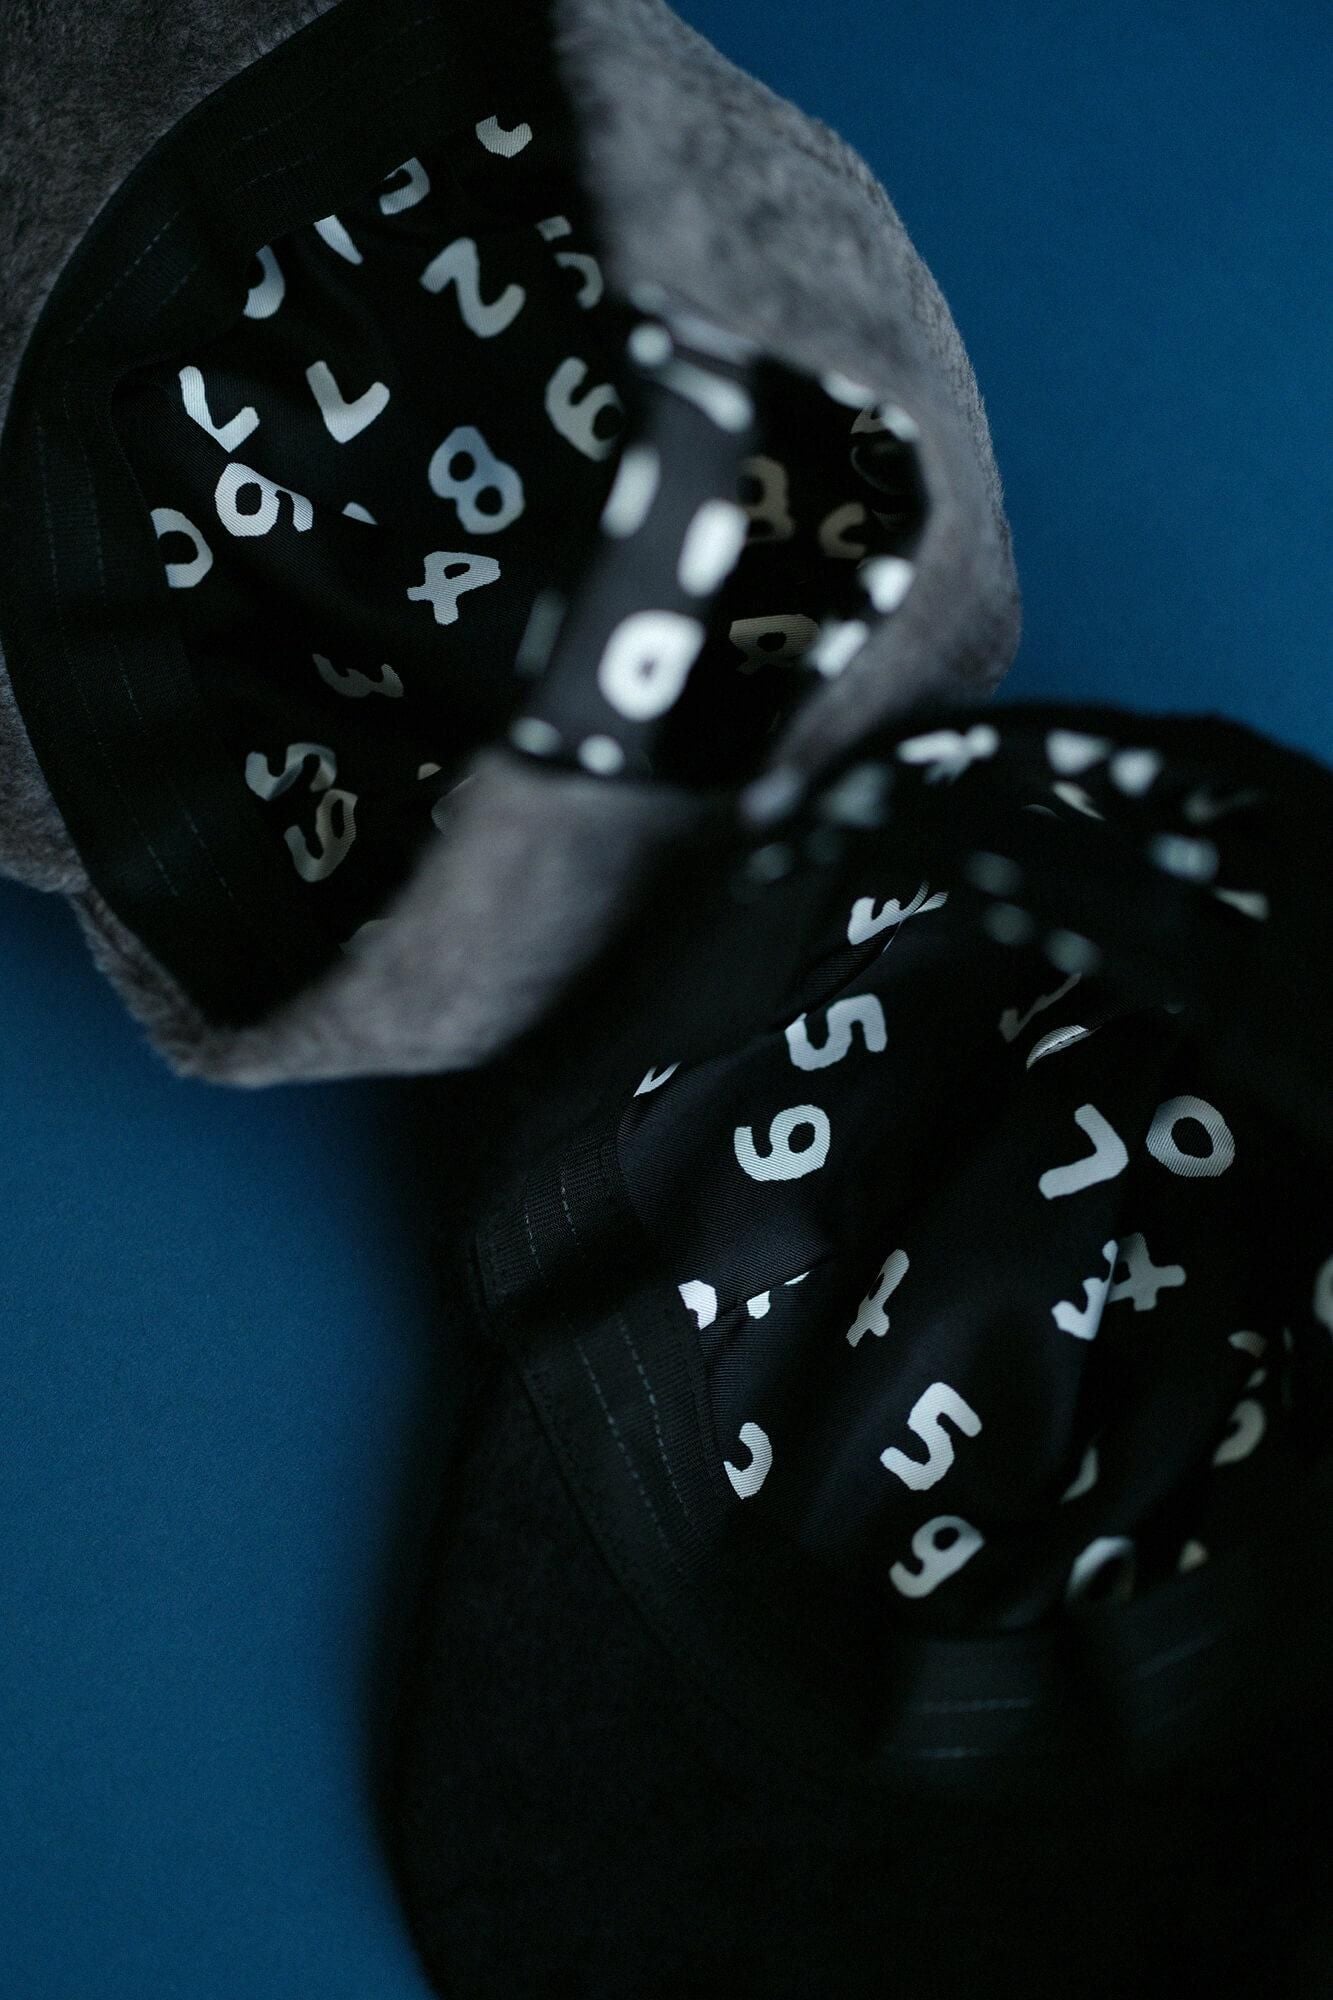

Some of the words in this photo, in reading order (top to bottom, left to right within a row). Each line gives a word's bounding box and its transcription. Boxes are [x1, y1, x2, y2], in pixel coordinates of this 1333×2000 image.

[306, 360, 391, 445] 7
[427, 425, 526, 535] 8
[406, 550, 502, 626] 4
[1038, 1103, 1130, 1200] 7
[1145, 1095, 1236, 1178] 0
[879, 1381, 983, 1491] 5
